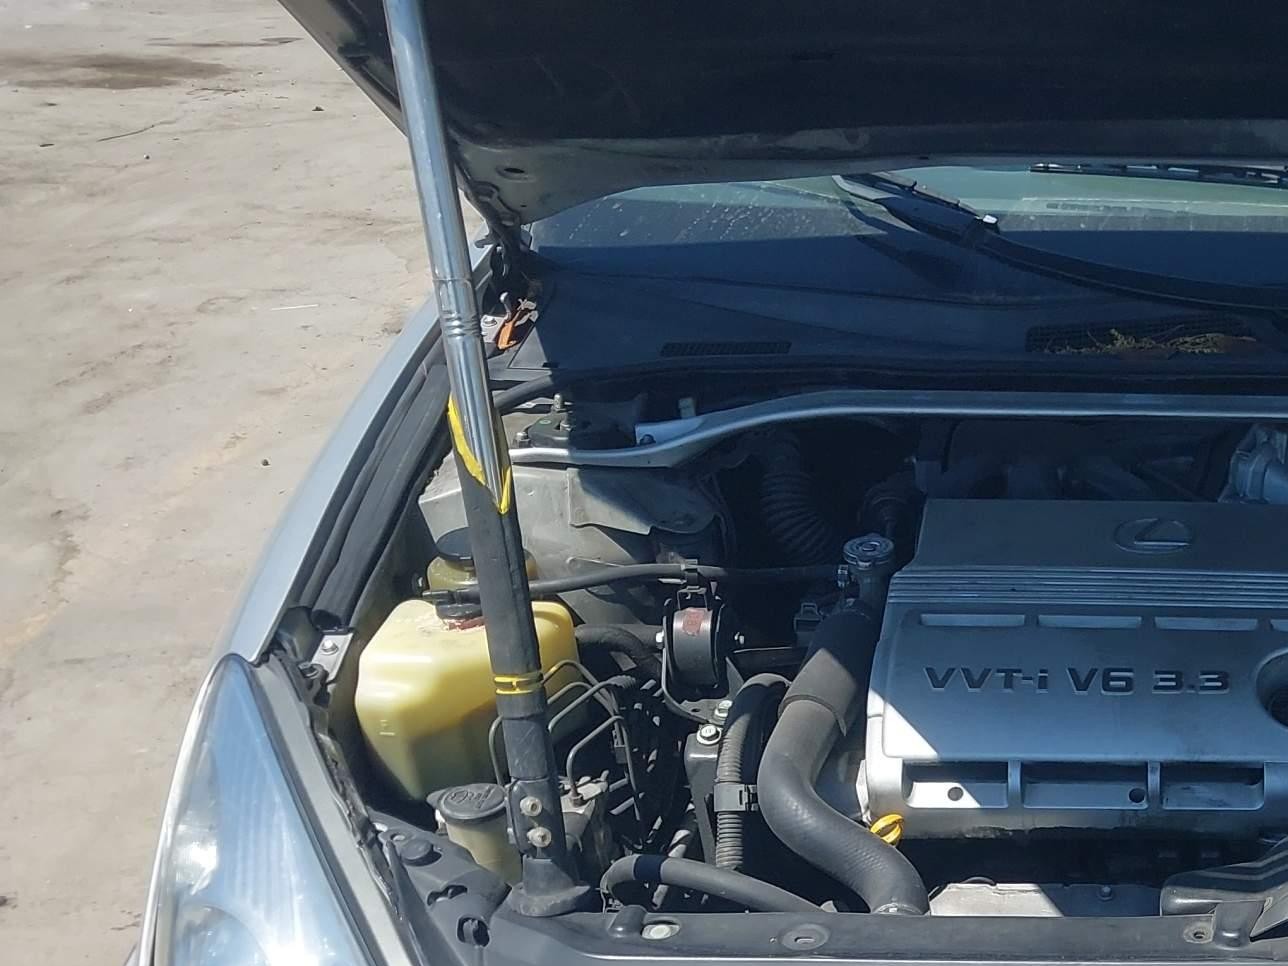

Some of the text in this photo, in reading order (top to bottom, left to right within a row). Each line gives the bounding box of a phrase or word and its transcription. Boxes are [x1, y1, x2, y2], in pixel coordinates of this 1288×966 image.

[922, 666, 1231, 696] VVT-i V6 3.3
